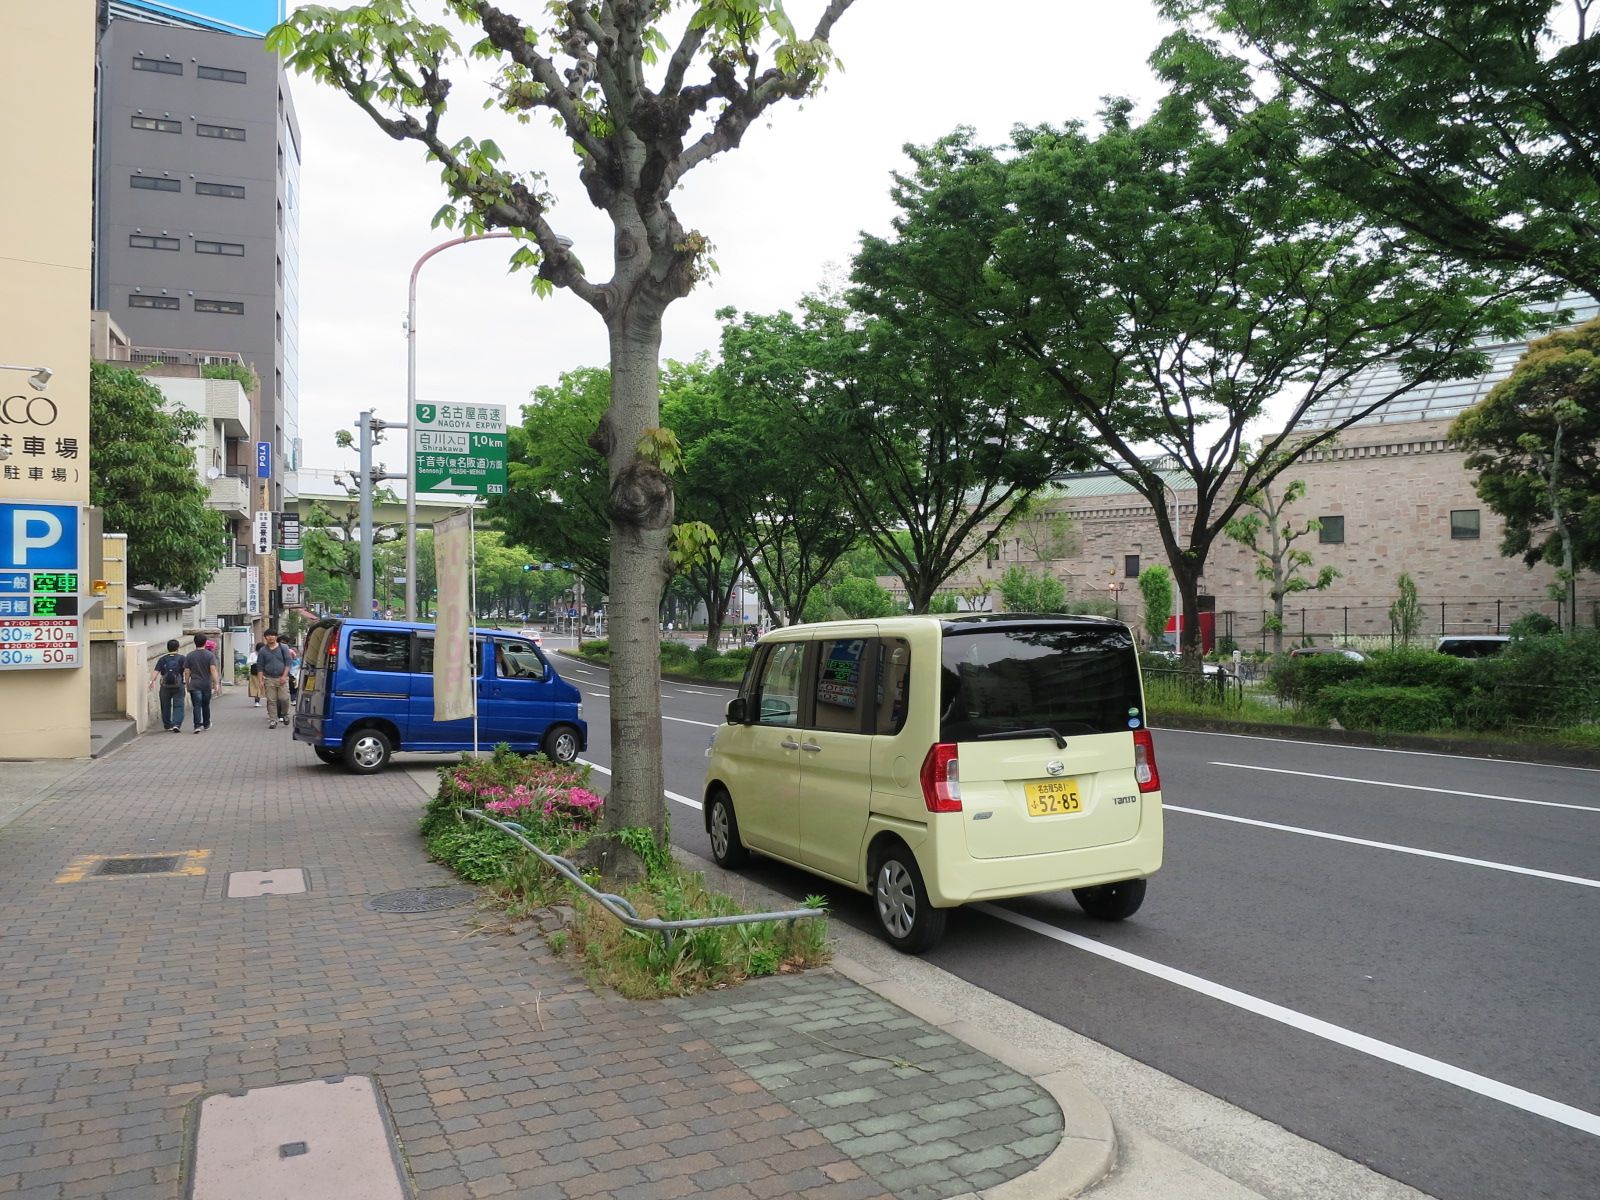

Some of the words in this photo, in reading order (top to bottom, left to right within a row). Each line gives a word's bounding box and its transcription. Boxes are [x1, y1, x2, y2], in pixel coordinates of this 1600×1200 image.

[0, 395, 58, 426] CO
[421, 406, 431, 419] 2
[440, 405, 500, 422] 名古屋高速
[438, 419, 471, 428] NAGOYA
[475, 421, 502, 430] EXPWY
[419, 432, 466, 446] 白川入口
[422, 444, 464, 453] Shirakawa
[12, 509, 63, 566] P
[0, 576, 28, 589] 一般
[33, 573, 77, 593] 空車
[0, 600, 28, 613] 月極
[33, 596, 57, 616] 空
[1, 628, 32, 641] 30分
[34, 627, 74, 640] 210円
[1, 650, 32, 664] 30分
[42, 649, 74, 662] 50円
